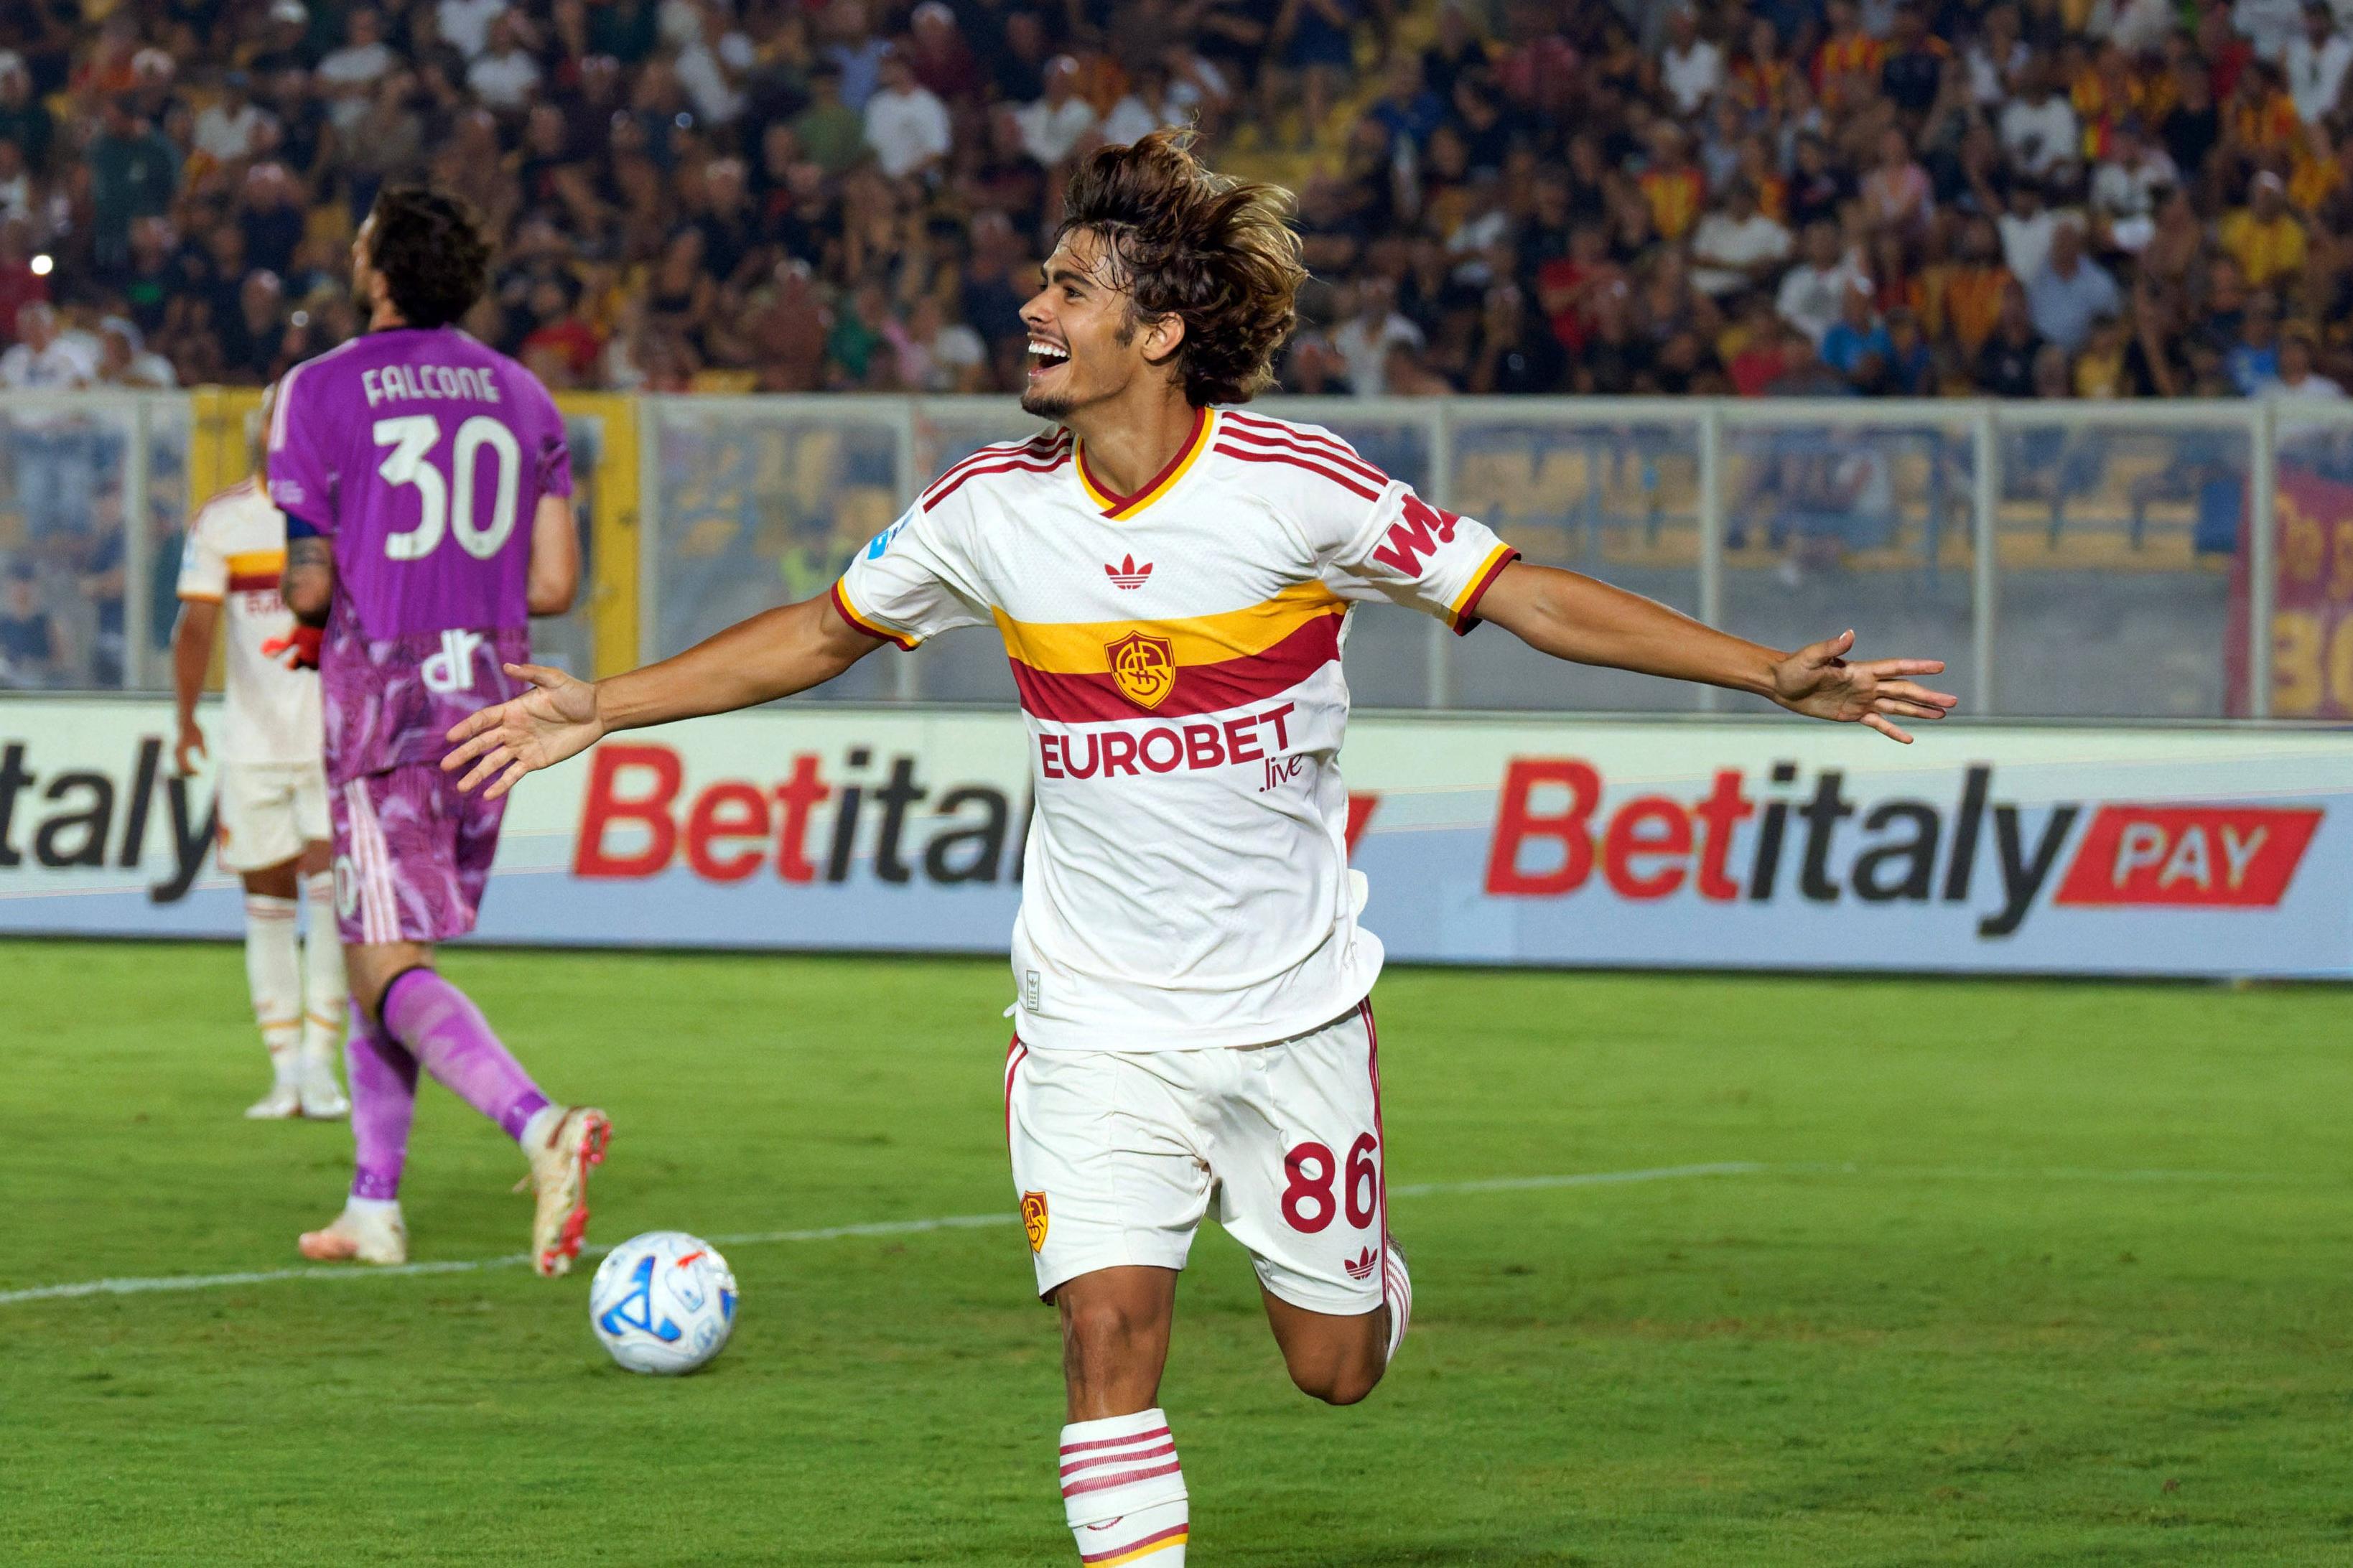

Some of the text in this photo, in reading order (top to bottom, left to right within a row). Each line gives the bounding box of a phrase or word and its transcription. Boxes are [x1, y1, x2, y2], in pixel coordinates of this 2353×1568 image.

[361, 364, 501, 409] FALCONE
[372, 414, 522, 561] 30
[420, 628, 483, 693] dr
[1038, 701, 1295, 780] EUROBET
[1258, 752, 1303, 793] .live
[573, 742, 1024, 884] Betita
[1483, 758, 2269, 939] Betitaly PAY
[1280, 1131, 1378, 1234] 86
